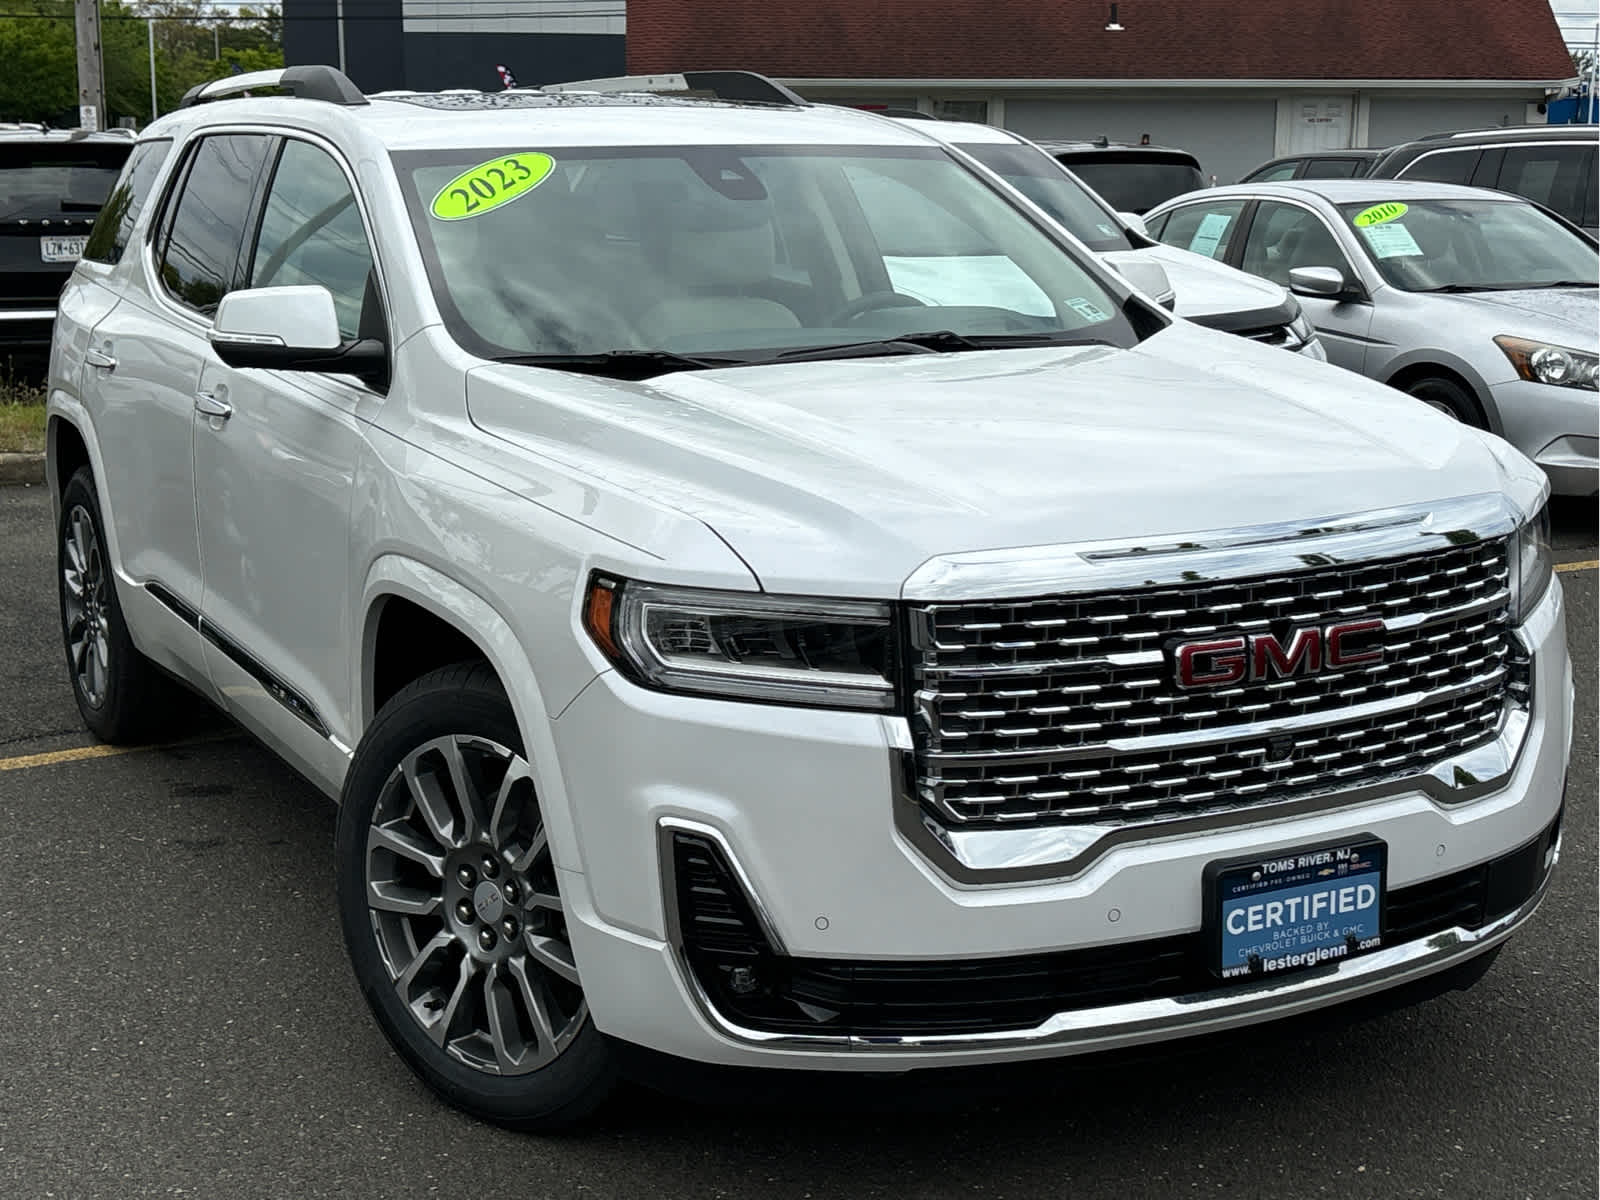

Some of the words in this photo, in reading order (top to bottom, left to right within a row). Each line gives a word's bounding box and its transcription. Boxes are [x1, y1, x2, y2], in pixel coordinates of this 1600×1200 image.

[450, 159, 531, 213] 2023
[1363, 203, 1398, 225] 2010
[1175, 617, 1385, 690] GMC
[1262, 858, 1295, 875] TOMS
[1298, 852, 1334, 868] RIVER,
[1336, 848, 1351, 861] NJ
[1232, 879, 1268, 894] CERTIFIED
[1226, 883, 1376, 936] CERTIFIED
[1238, 936, 1297, 958] CHEVROLET
[1300, 932, 1331, 944] BUICK
[1333, 929, 1340, 938] &
[1342, 923, 1364, 936] GMC
[1272, 924, 1313, 941] BACKED
[1316, 921, 1329, 931] BY
[1263, 944, 1348, 973] lesterglenn
